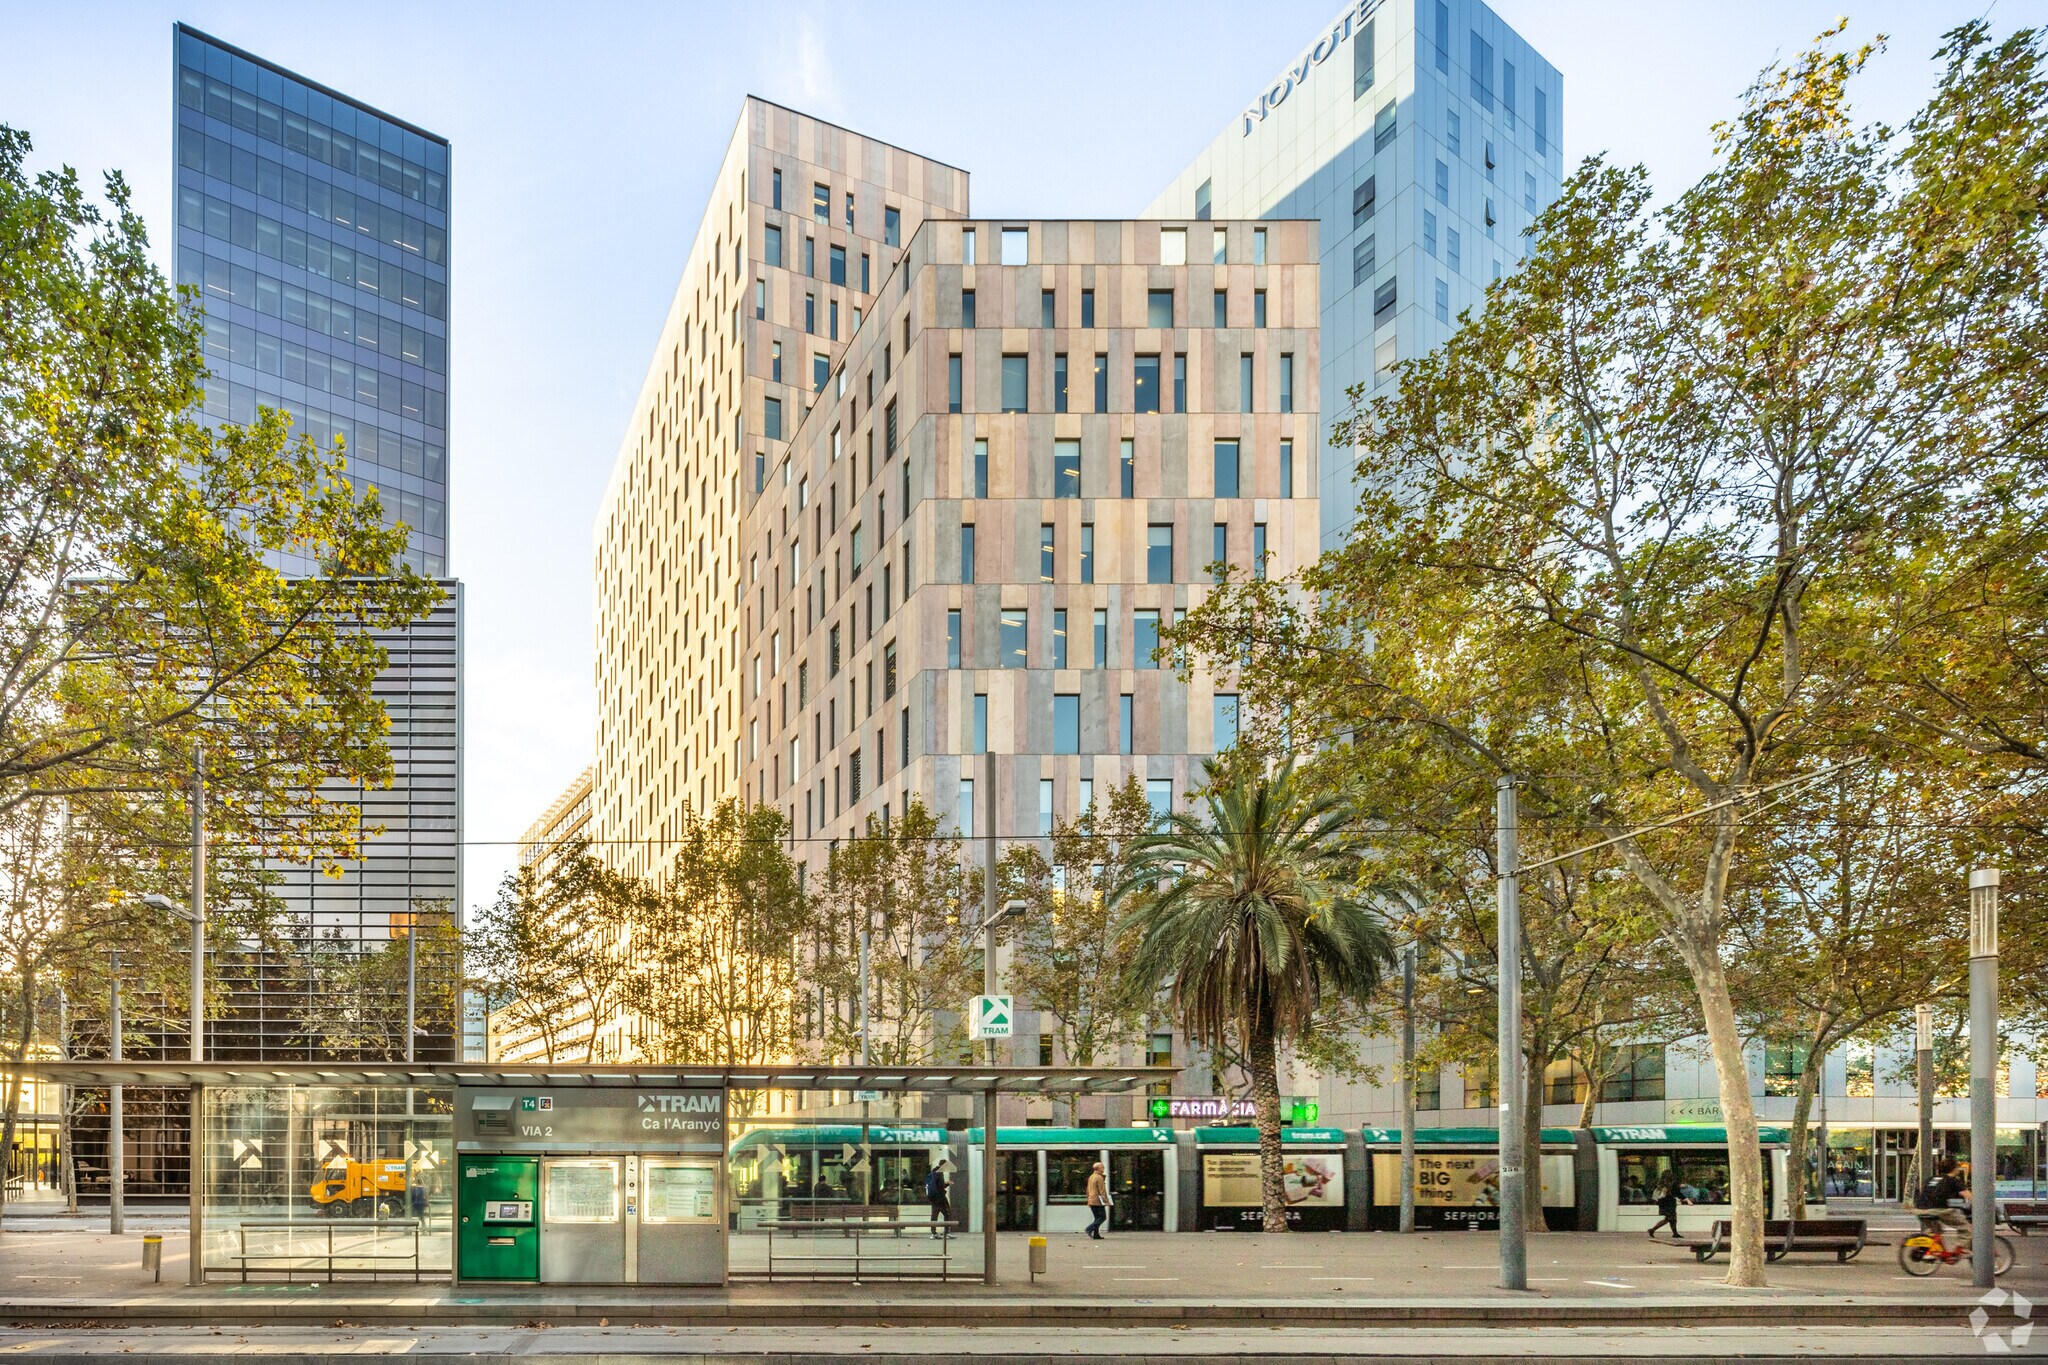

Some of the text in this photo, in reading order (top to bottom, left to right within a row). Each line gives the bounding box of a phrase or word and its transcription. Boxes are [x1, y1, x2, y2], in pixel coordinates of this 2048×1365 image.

[1243, 0, 1385, 137] NOVOTE
[523, 1099, 535, 1108] T4
[656, 1095, 720, 1112] TRAM
[1698, 1107, 1719, 1115] BAR
[642, 1117, 720, 1132] Ca l'Aranyó
[521, 1126, 553, 1136] VIA 2
[893, 1130, 939, 1142] TRAM
[1621, 1129, 1667, 1140] TRAM
[1419, 1159, 1475, 1169] The next
[1420, 1172, 1451, 1185] BIG
[1419, 1188, 1457, 1201] thing.
[1241, 1211, 1301, 1220] SEPRA
